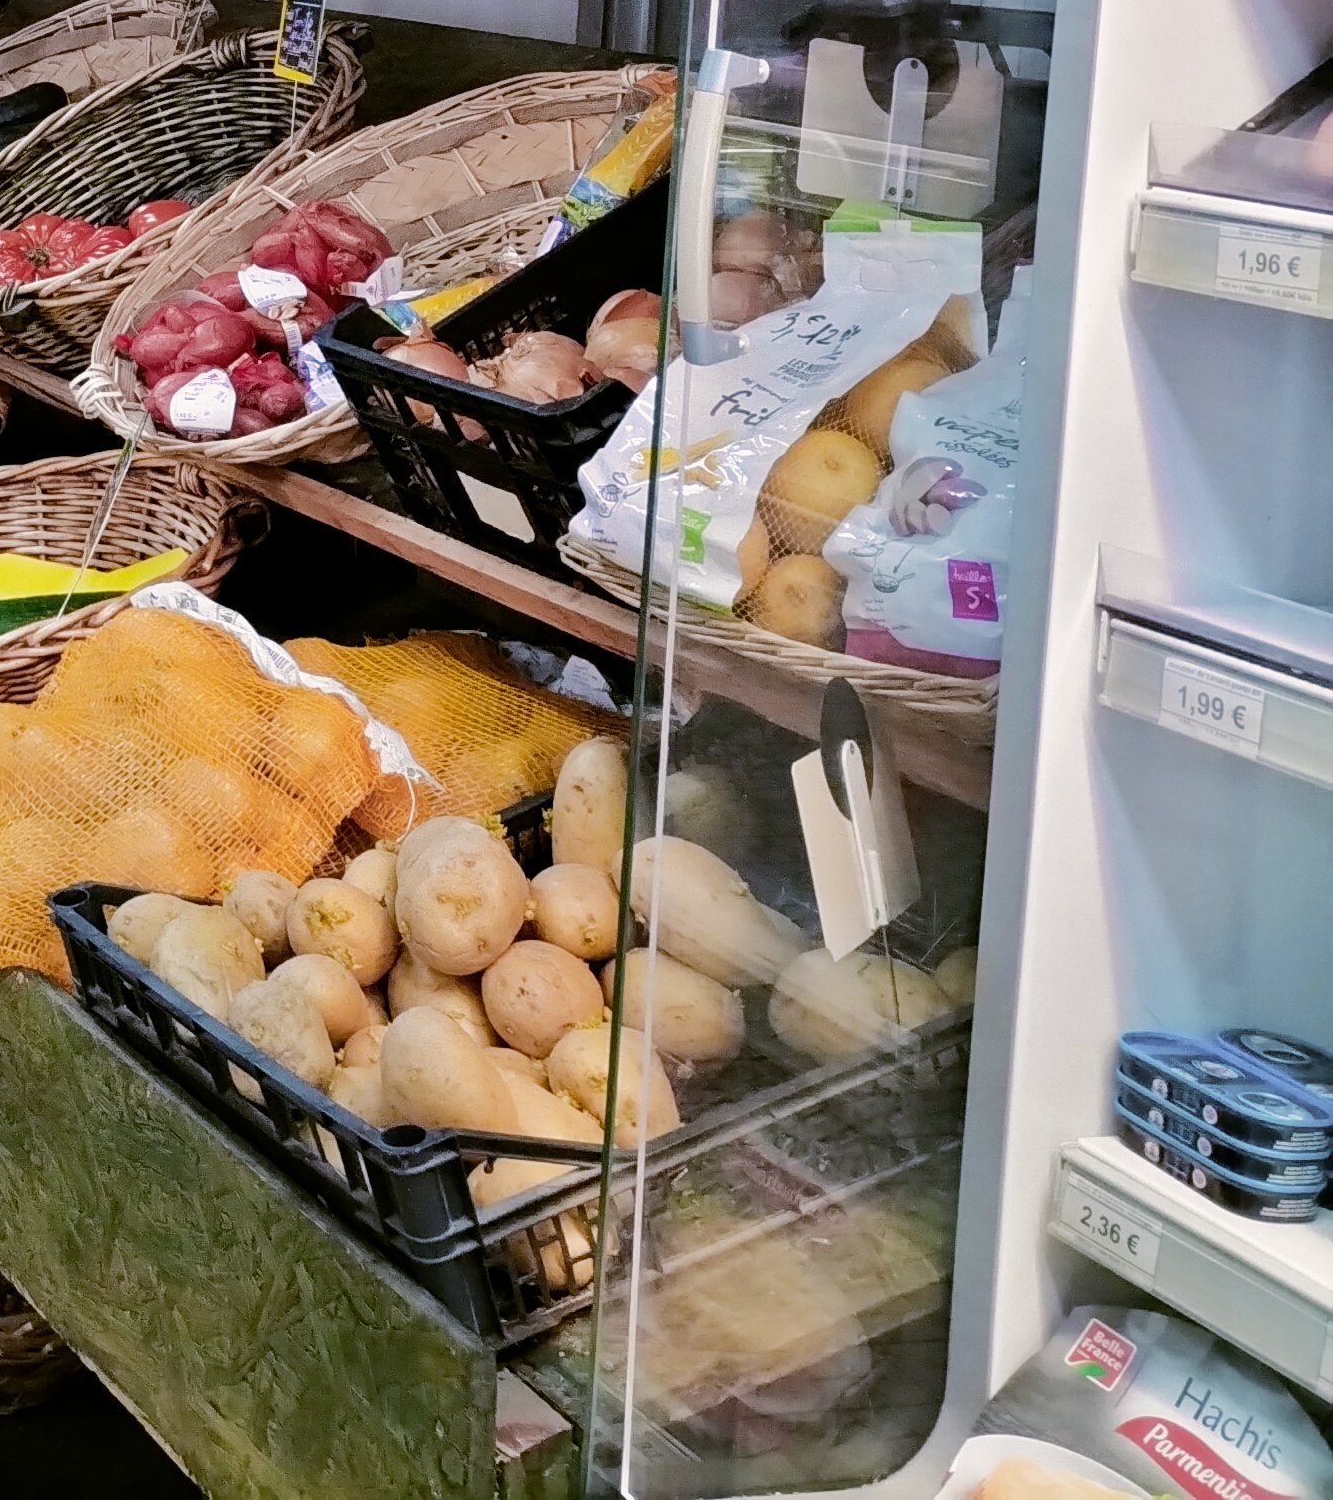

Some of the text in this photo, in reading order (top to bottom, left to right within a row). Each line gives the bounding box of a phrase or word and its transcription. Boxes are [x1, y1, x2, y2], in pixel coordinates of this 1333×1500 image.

[1238, 248, 1301, 278] 1,96 €
[787, 358, 809, 370] LES
[936, 439, 1019, 469] rissolées
[965, 585, 981, 610] S
[1177, 685, 1247, 731] 1,99 €
[1080, 1205, 1141, 1257] 2,36 €
[1081, 1337, 1124, 1373] France
[1092, 1330, 1126, 1359] Belle
[1173, 1376, 1283, 1471] Hachis
